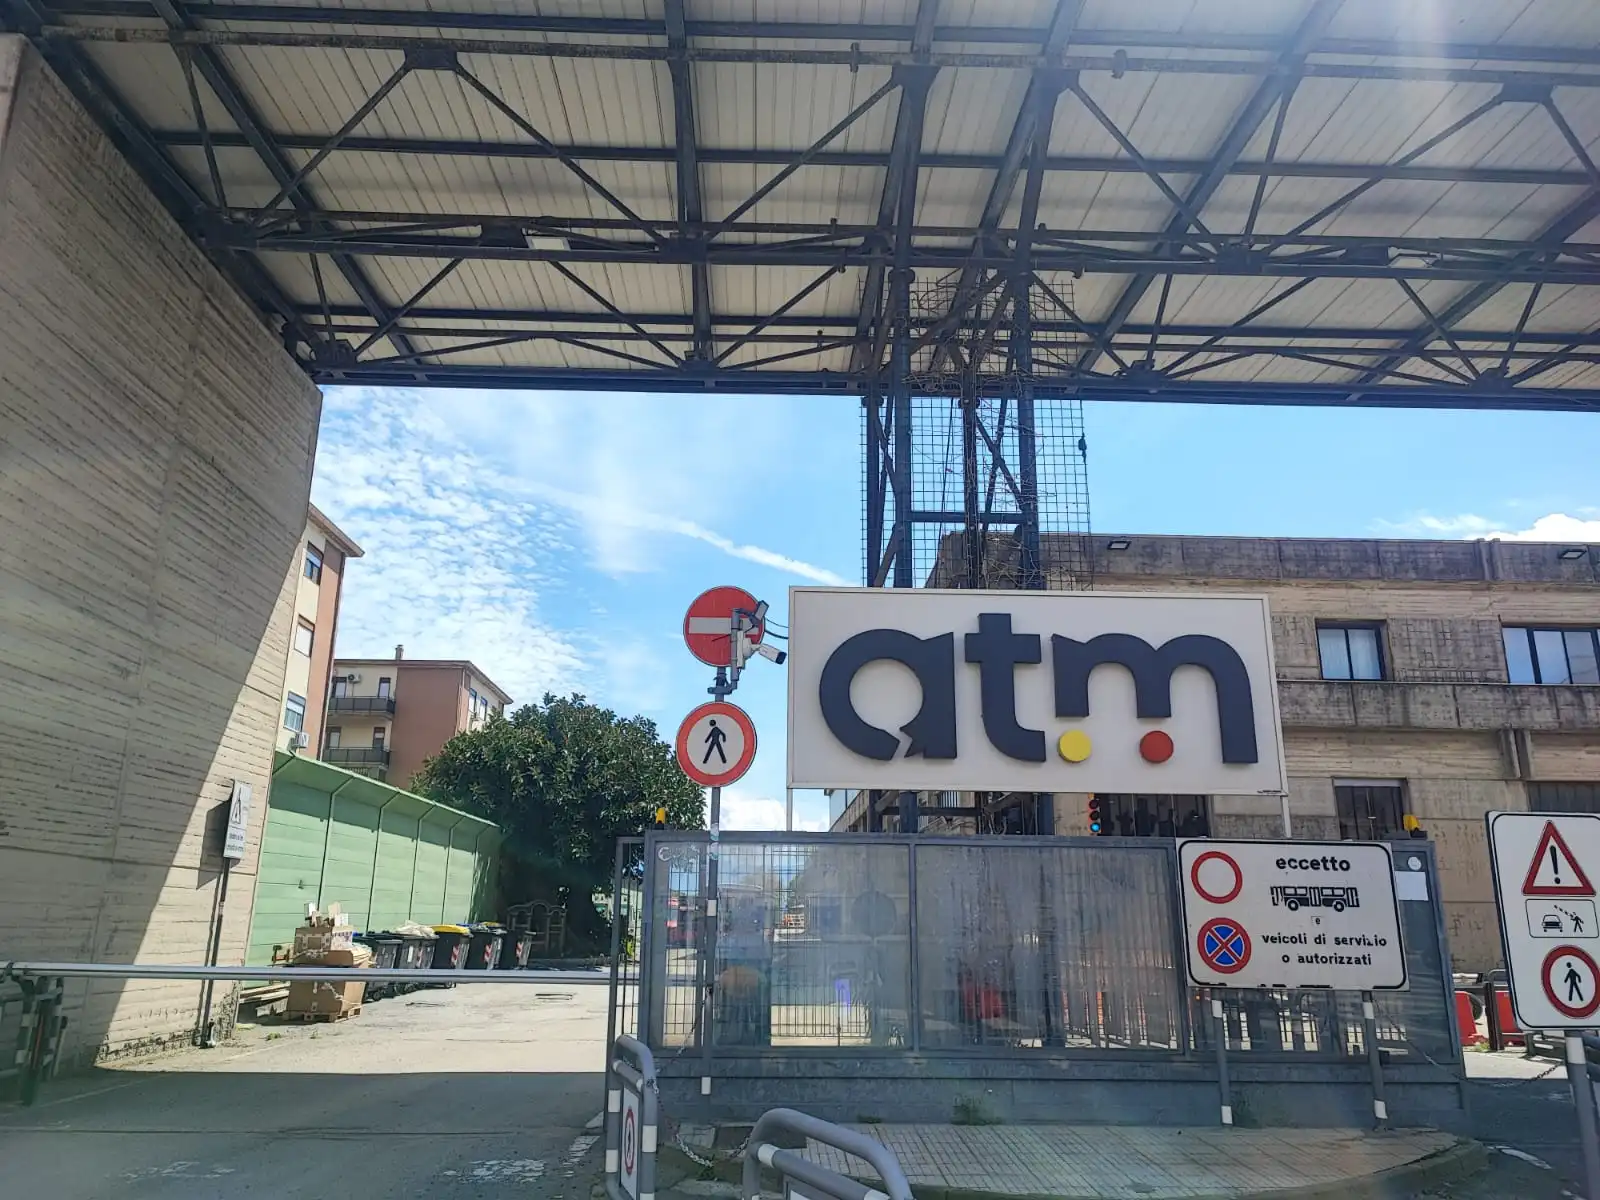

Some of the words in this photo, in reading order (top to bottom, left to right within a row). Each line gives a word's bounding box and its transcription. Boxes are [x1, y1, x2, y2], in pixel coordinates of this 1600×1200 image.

[819, 612, 1258, 764] atm
[1275, 855, 1350, 871] eccetto
[1261, 932, 1307, 944] veicoli
[1313, 932, 1326, 944] di
[1333, 934, 1387, 946] servizio
[1281, 953, 1290, 963] o
[1297, 952, 1372, 965] autorizzati
